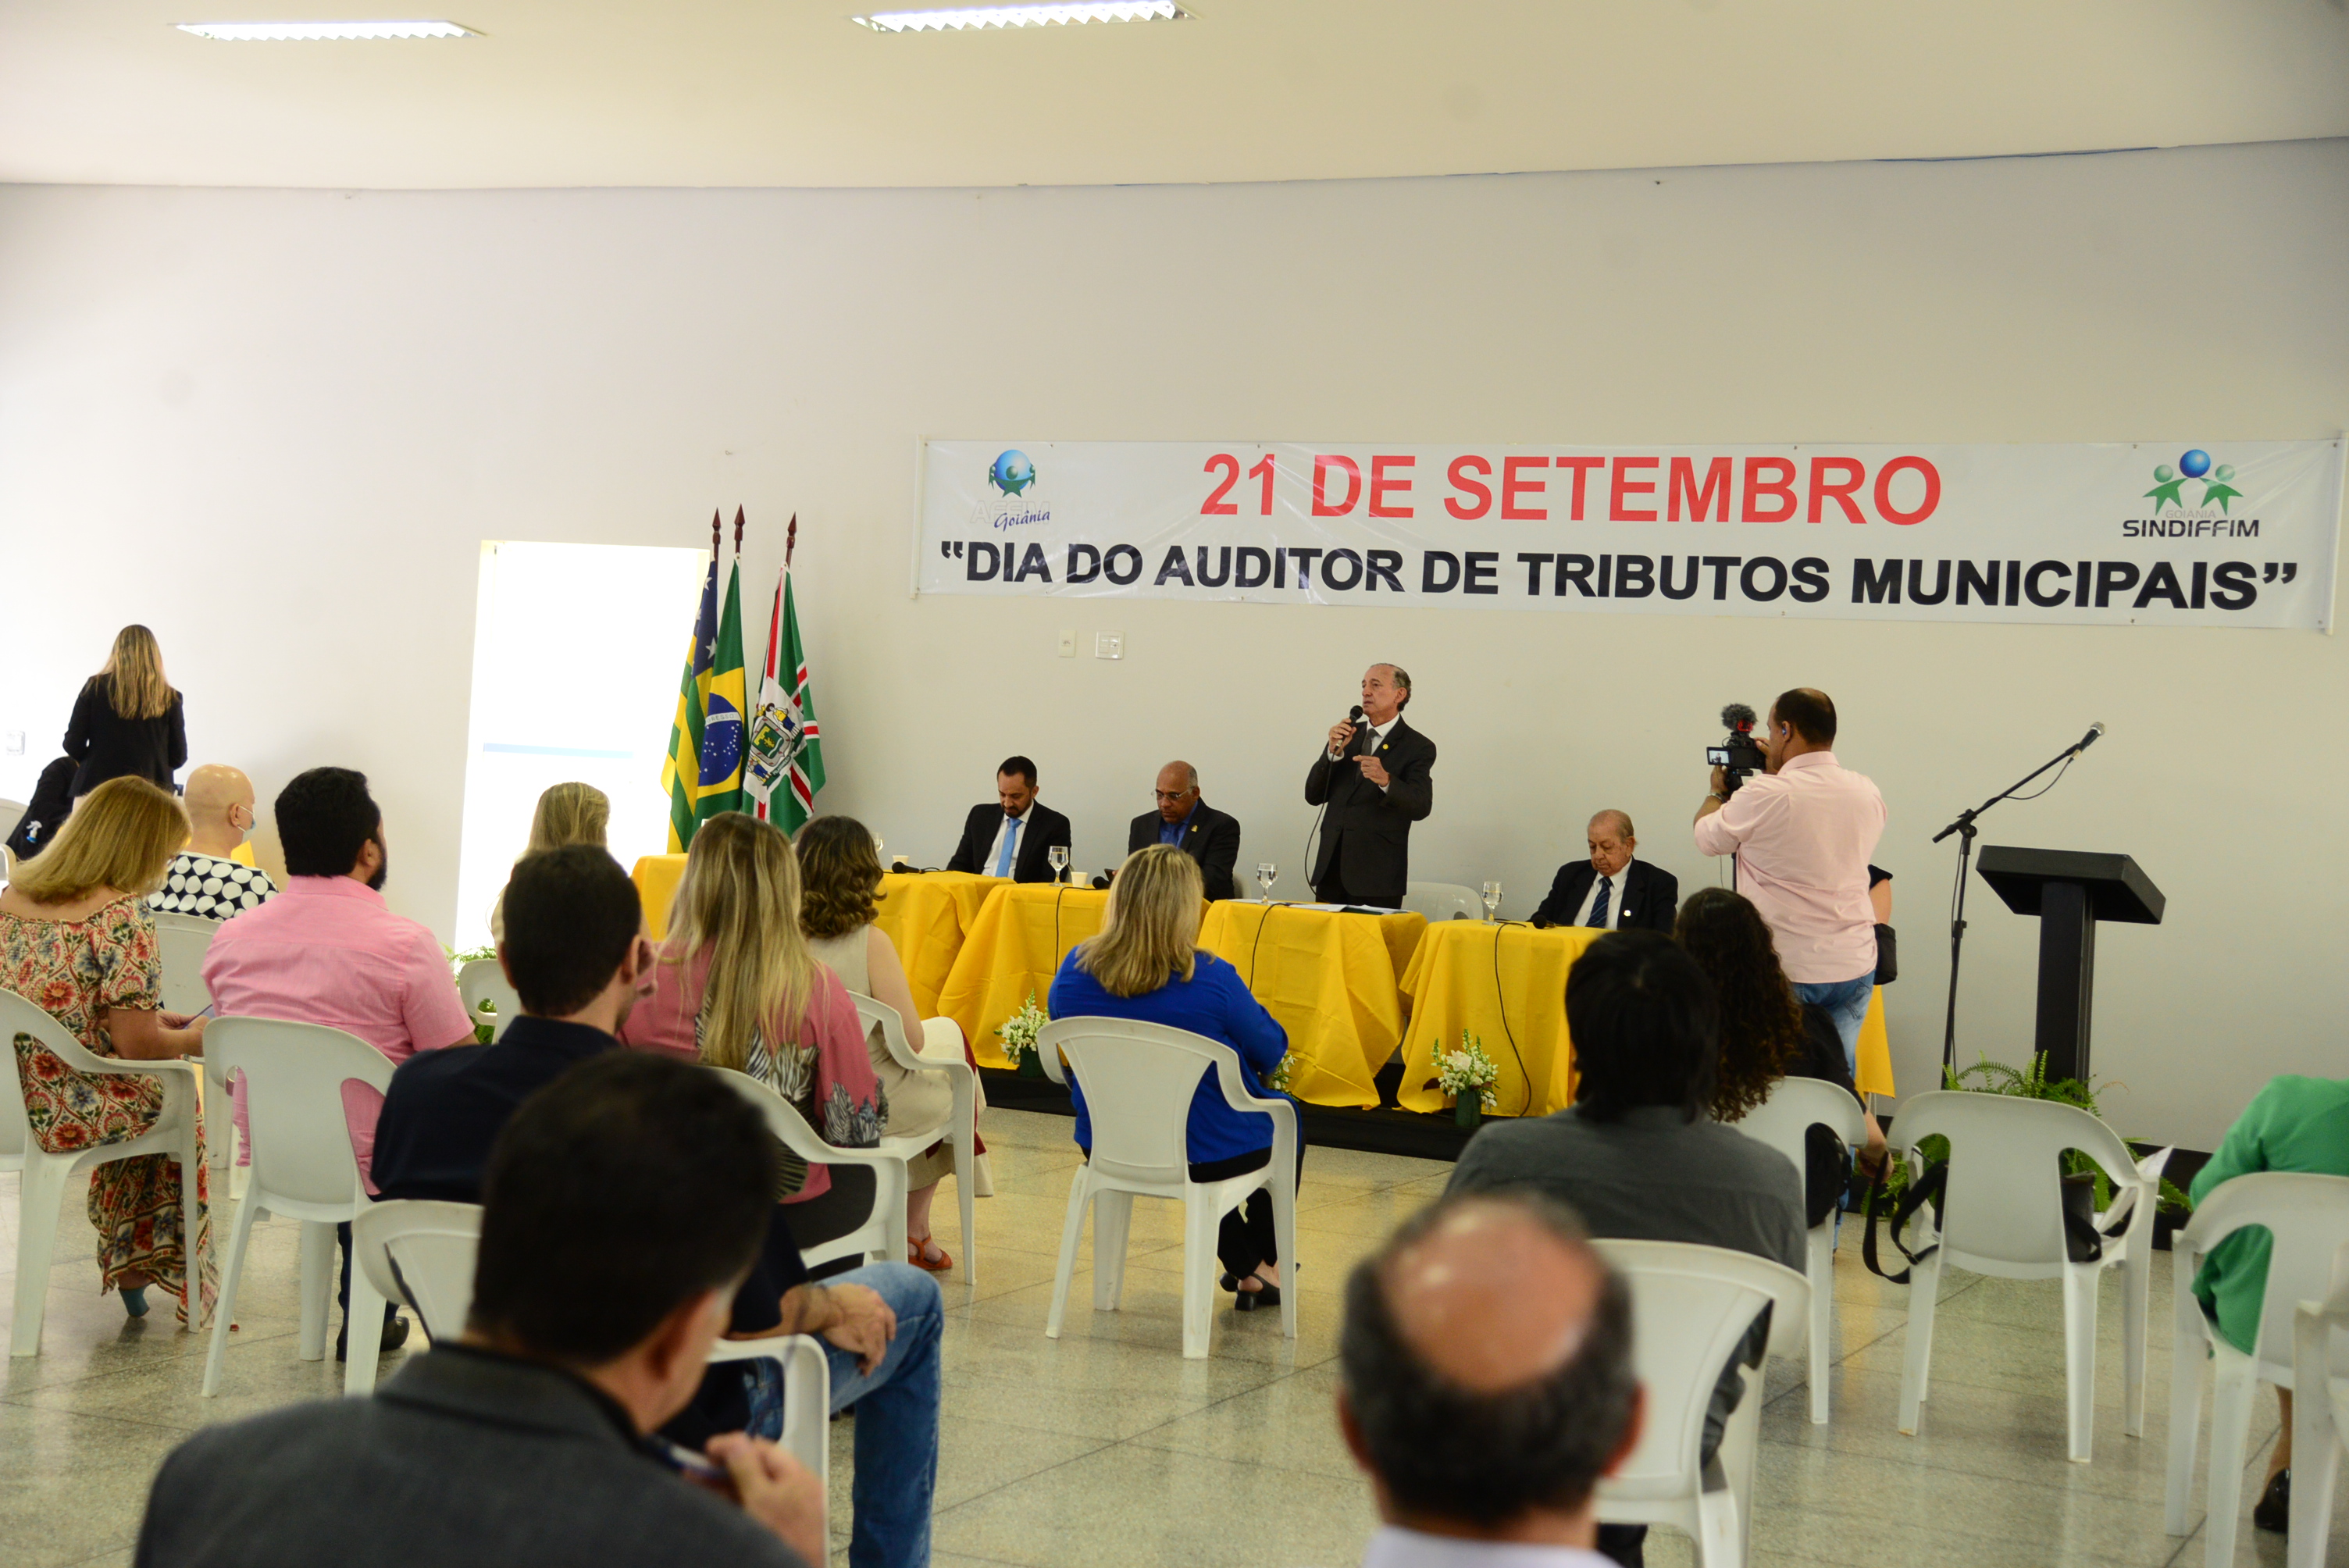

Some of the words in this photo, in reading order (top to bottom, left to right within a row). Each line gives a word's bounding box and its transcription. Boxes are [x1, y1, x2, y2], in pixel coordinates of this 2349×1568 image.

[1200, 453, 1275, 516] 21
[1311, 454, 1417, 519] DE
[1444, 454, 1942, 526] SETEMBRO
[993, 510, 1050, 532] Goiânia
[2123, 519, 2259, 537] SINDIFFIM
[941, 540, 1053, 583] “DIA
[1067, 543, 1143, 586] DO
[1153, 545, 1406, 593] AUDITOR
[1421, 551, 1499, 595] DE
[1517, 552, 1830, 603] TRIBUTOS
[1851, 558, 2298, 611] MUNICIPAIS”
